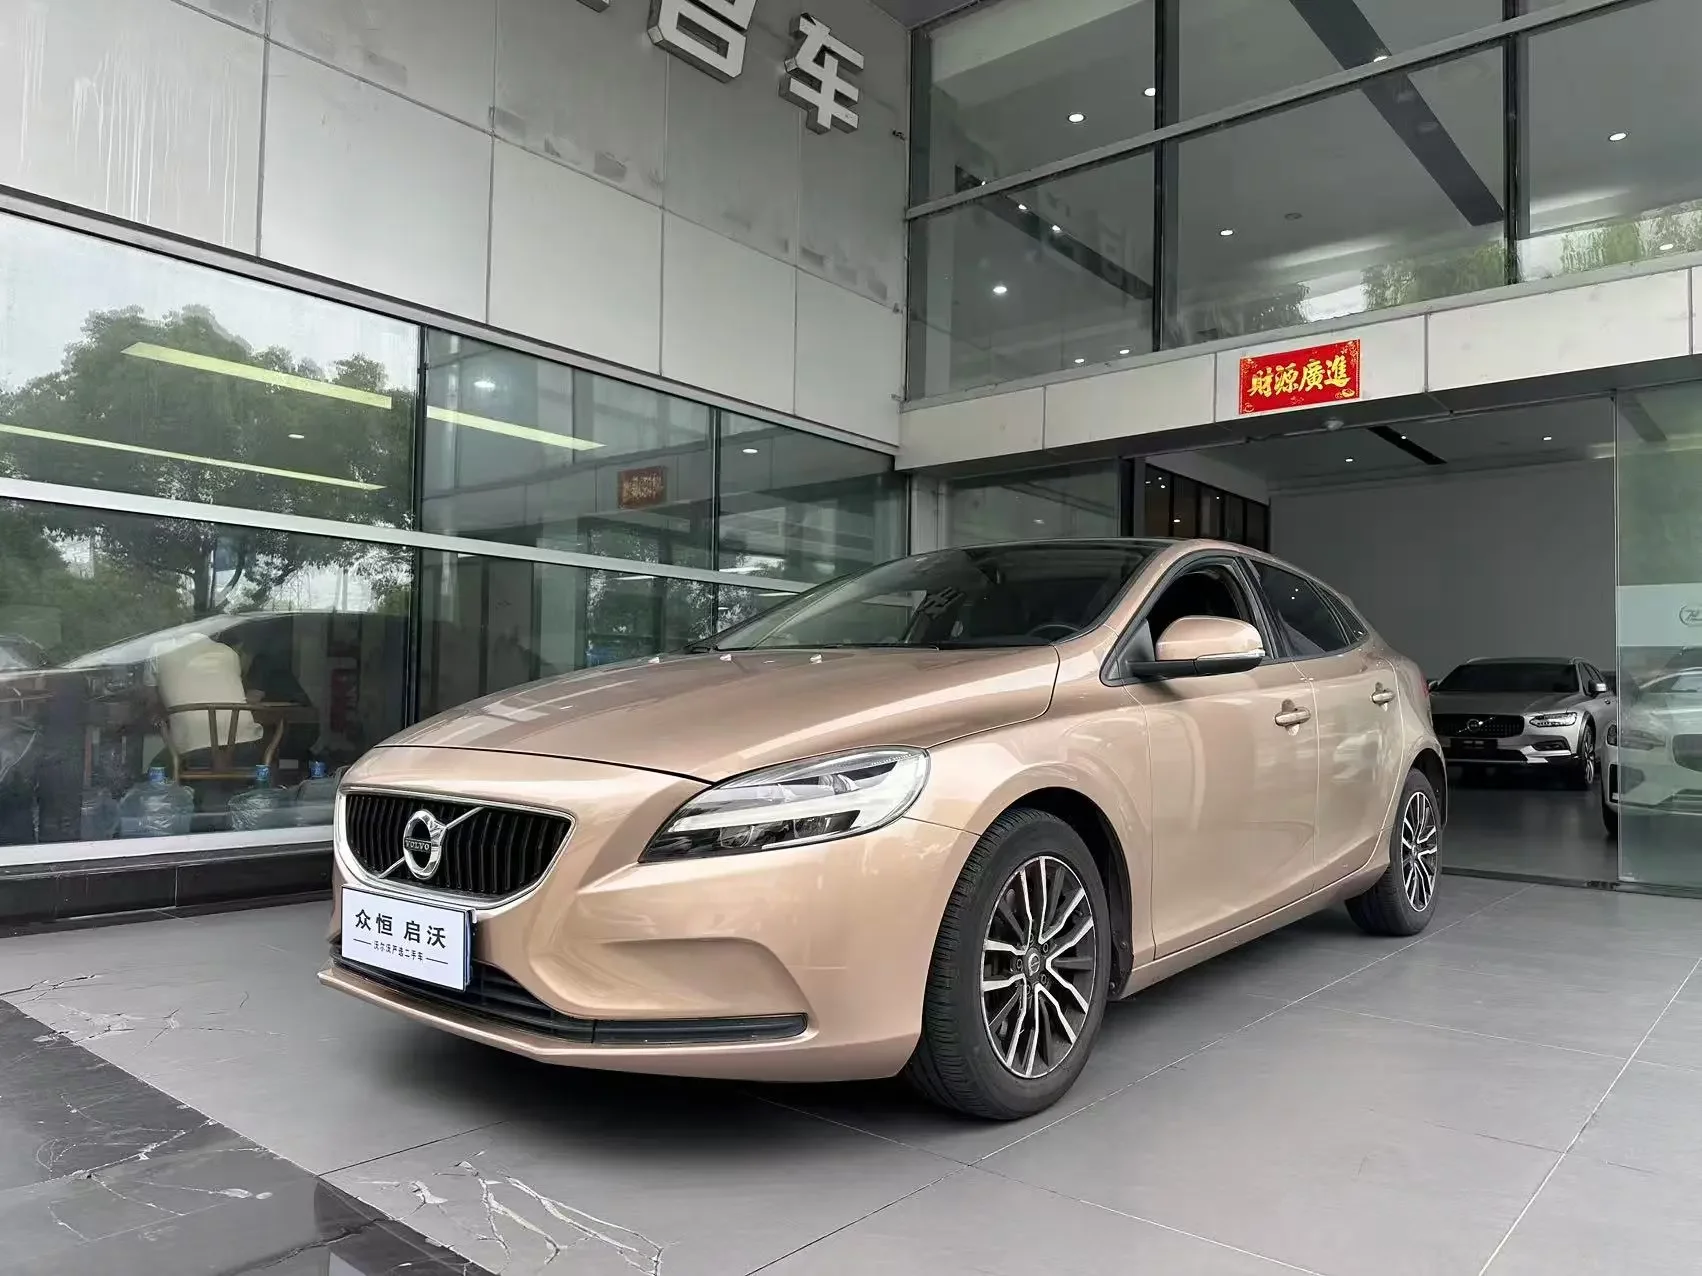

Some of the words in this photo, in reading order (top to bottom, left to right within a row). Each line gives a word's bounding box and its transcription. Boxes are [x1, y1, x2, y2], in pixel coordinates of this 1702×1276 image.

[1247, 355, 1351, 398] 財源廣進
[405, 840, 430, 851] VOLVO
[354, 909, 393, 937] 众恒
[403, 920, 447, 949] 启沃
